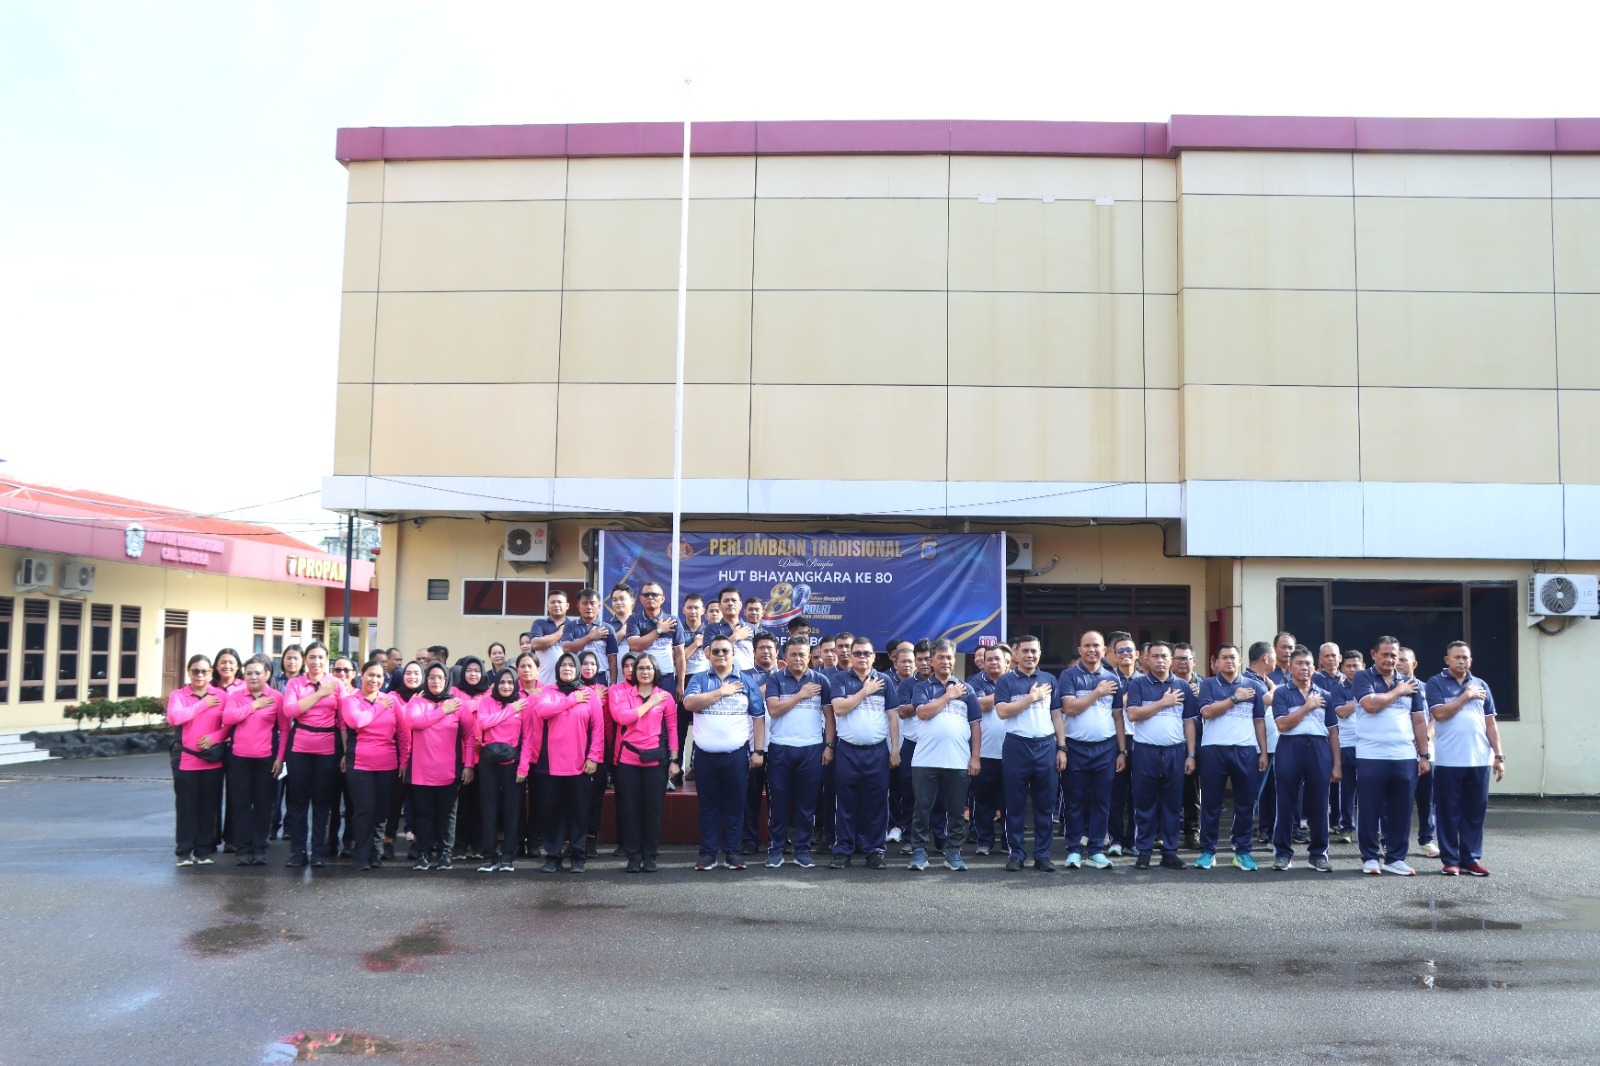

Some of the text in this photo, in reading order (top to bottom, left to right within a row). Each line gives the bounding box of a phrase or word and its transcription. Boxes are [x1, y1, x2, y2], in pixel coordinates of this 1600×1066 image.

[709, 538, 903, 558] PERLOMBAAN TRADISIONAL
[718, 570, 893, 584] HUT BHAYANGKARA KE 80
